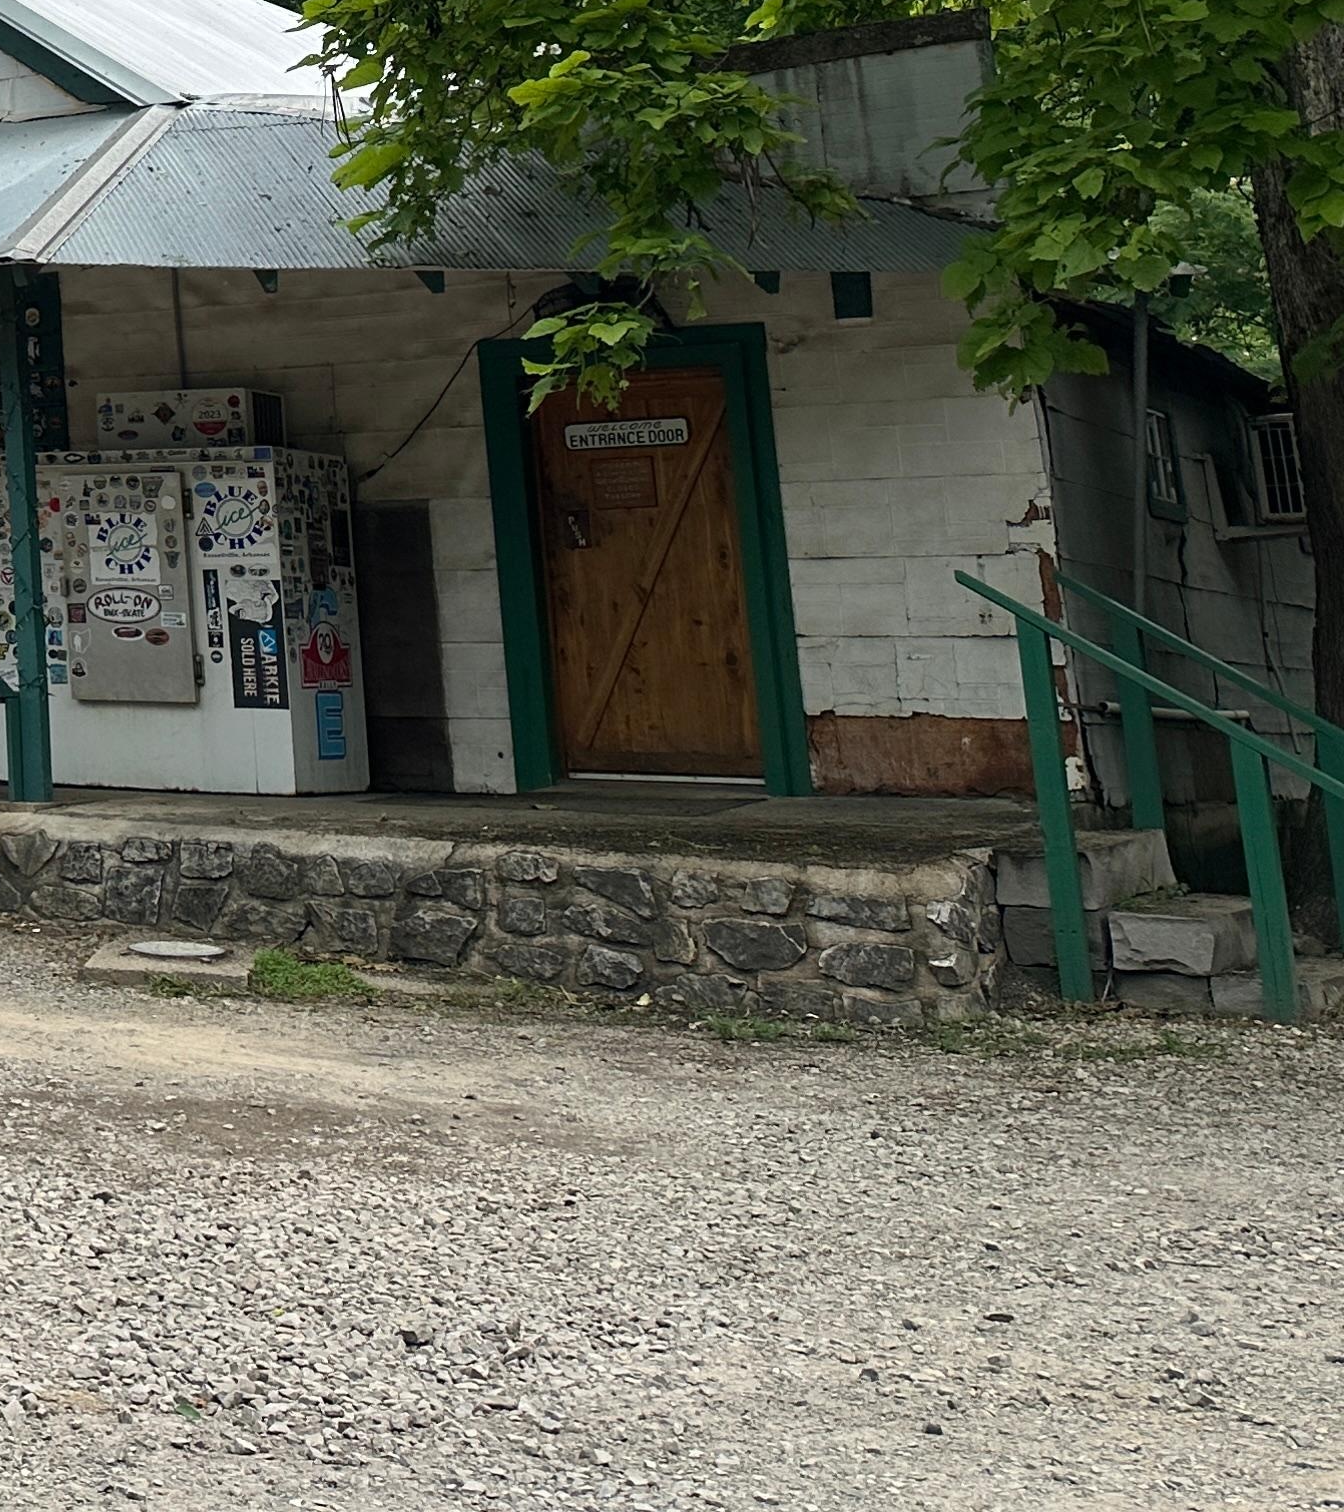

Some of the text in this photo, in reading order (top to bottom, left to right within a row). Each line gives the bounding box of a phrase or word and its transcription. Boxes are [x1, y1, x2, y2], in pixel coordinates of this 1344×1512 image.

[198, 410, 222, 419] 2023
[570, 428, 685, 447] ENTRANCE DOOR
[203, 485, 258, 517] BLUE
[96, 513, 148, 543] BLUE
[105, 546, 153, 575] CHIP
[240, 637, 258, 697] SOLD HERE
[261, 654, 280, 705] ARKIE
